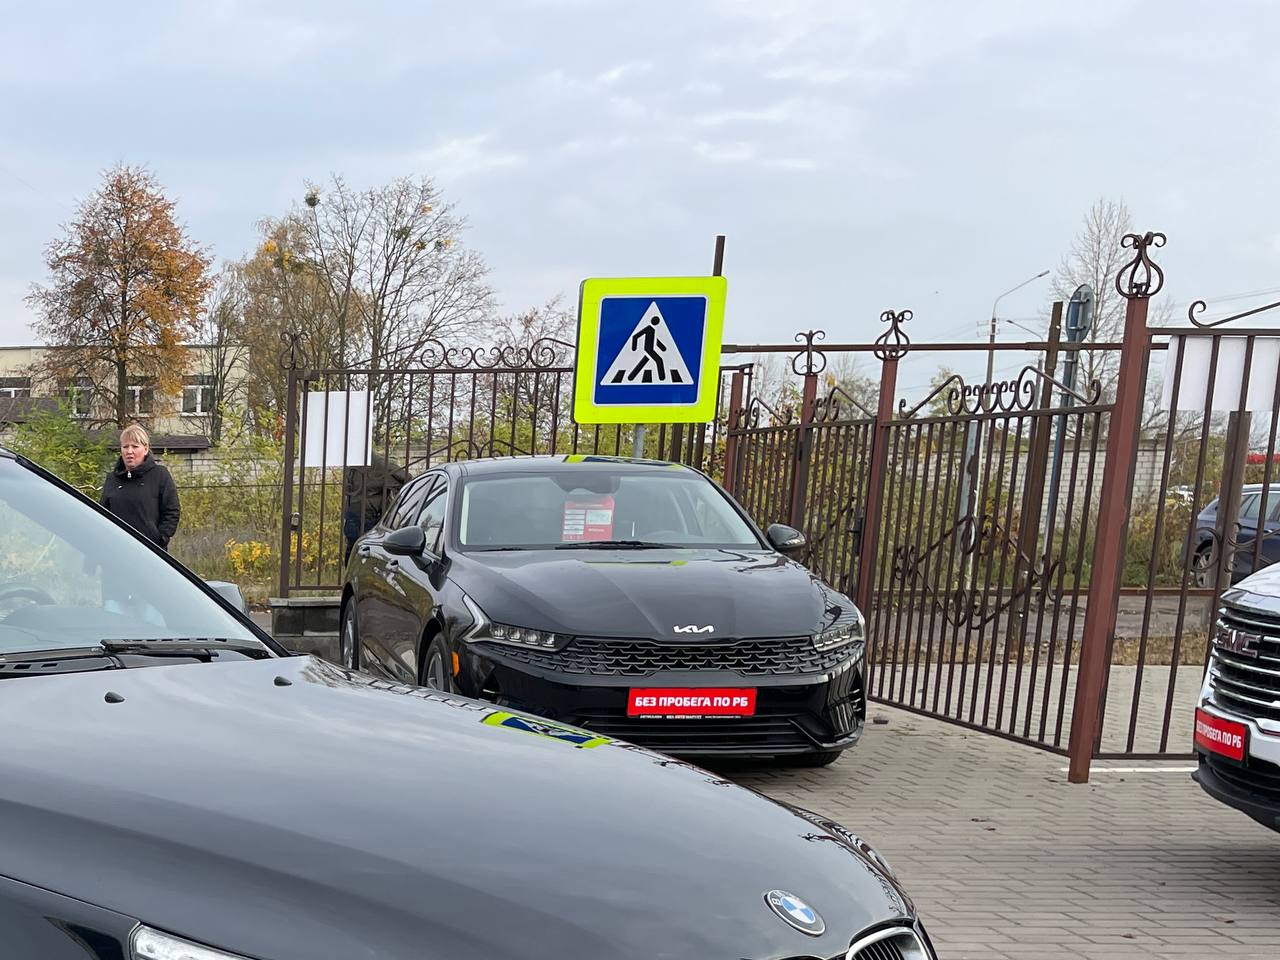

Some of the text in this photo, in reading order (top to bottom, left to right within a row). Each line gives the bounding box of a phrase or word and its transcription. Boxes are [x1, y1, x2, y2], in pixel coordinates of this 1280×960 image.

[673, 625, 714, 633] KIA
[635, 697, 748, 707] БЕЗ ПРОБЕГА ПО РБ
[1222, 731, 1232, 746] ПО
[1232, 734, 1242, 749] РБ
